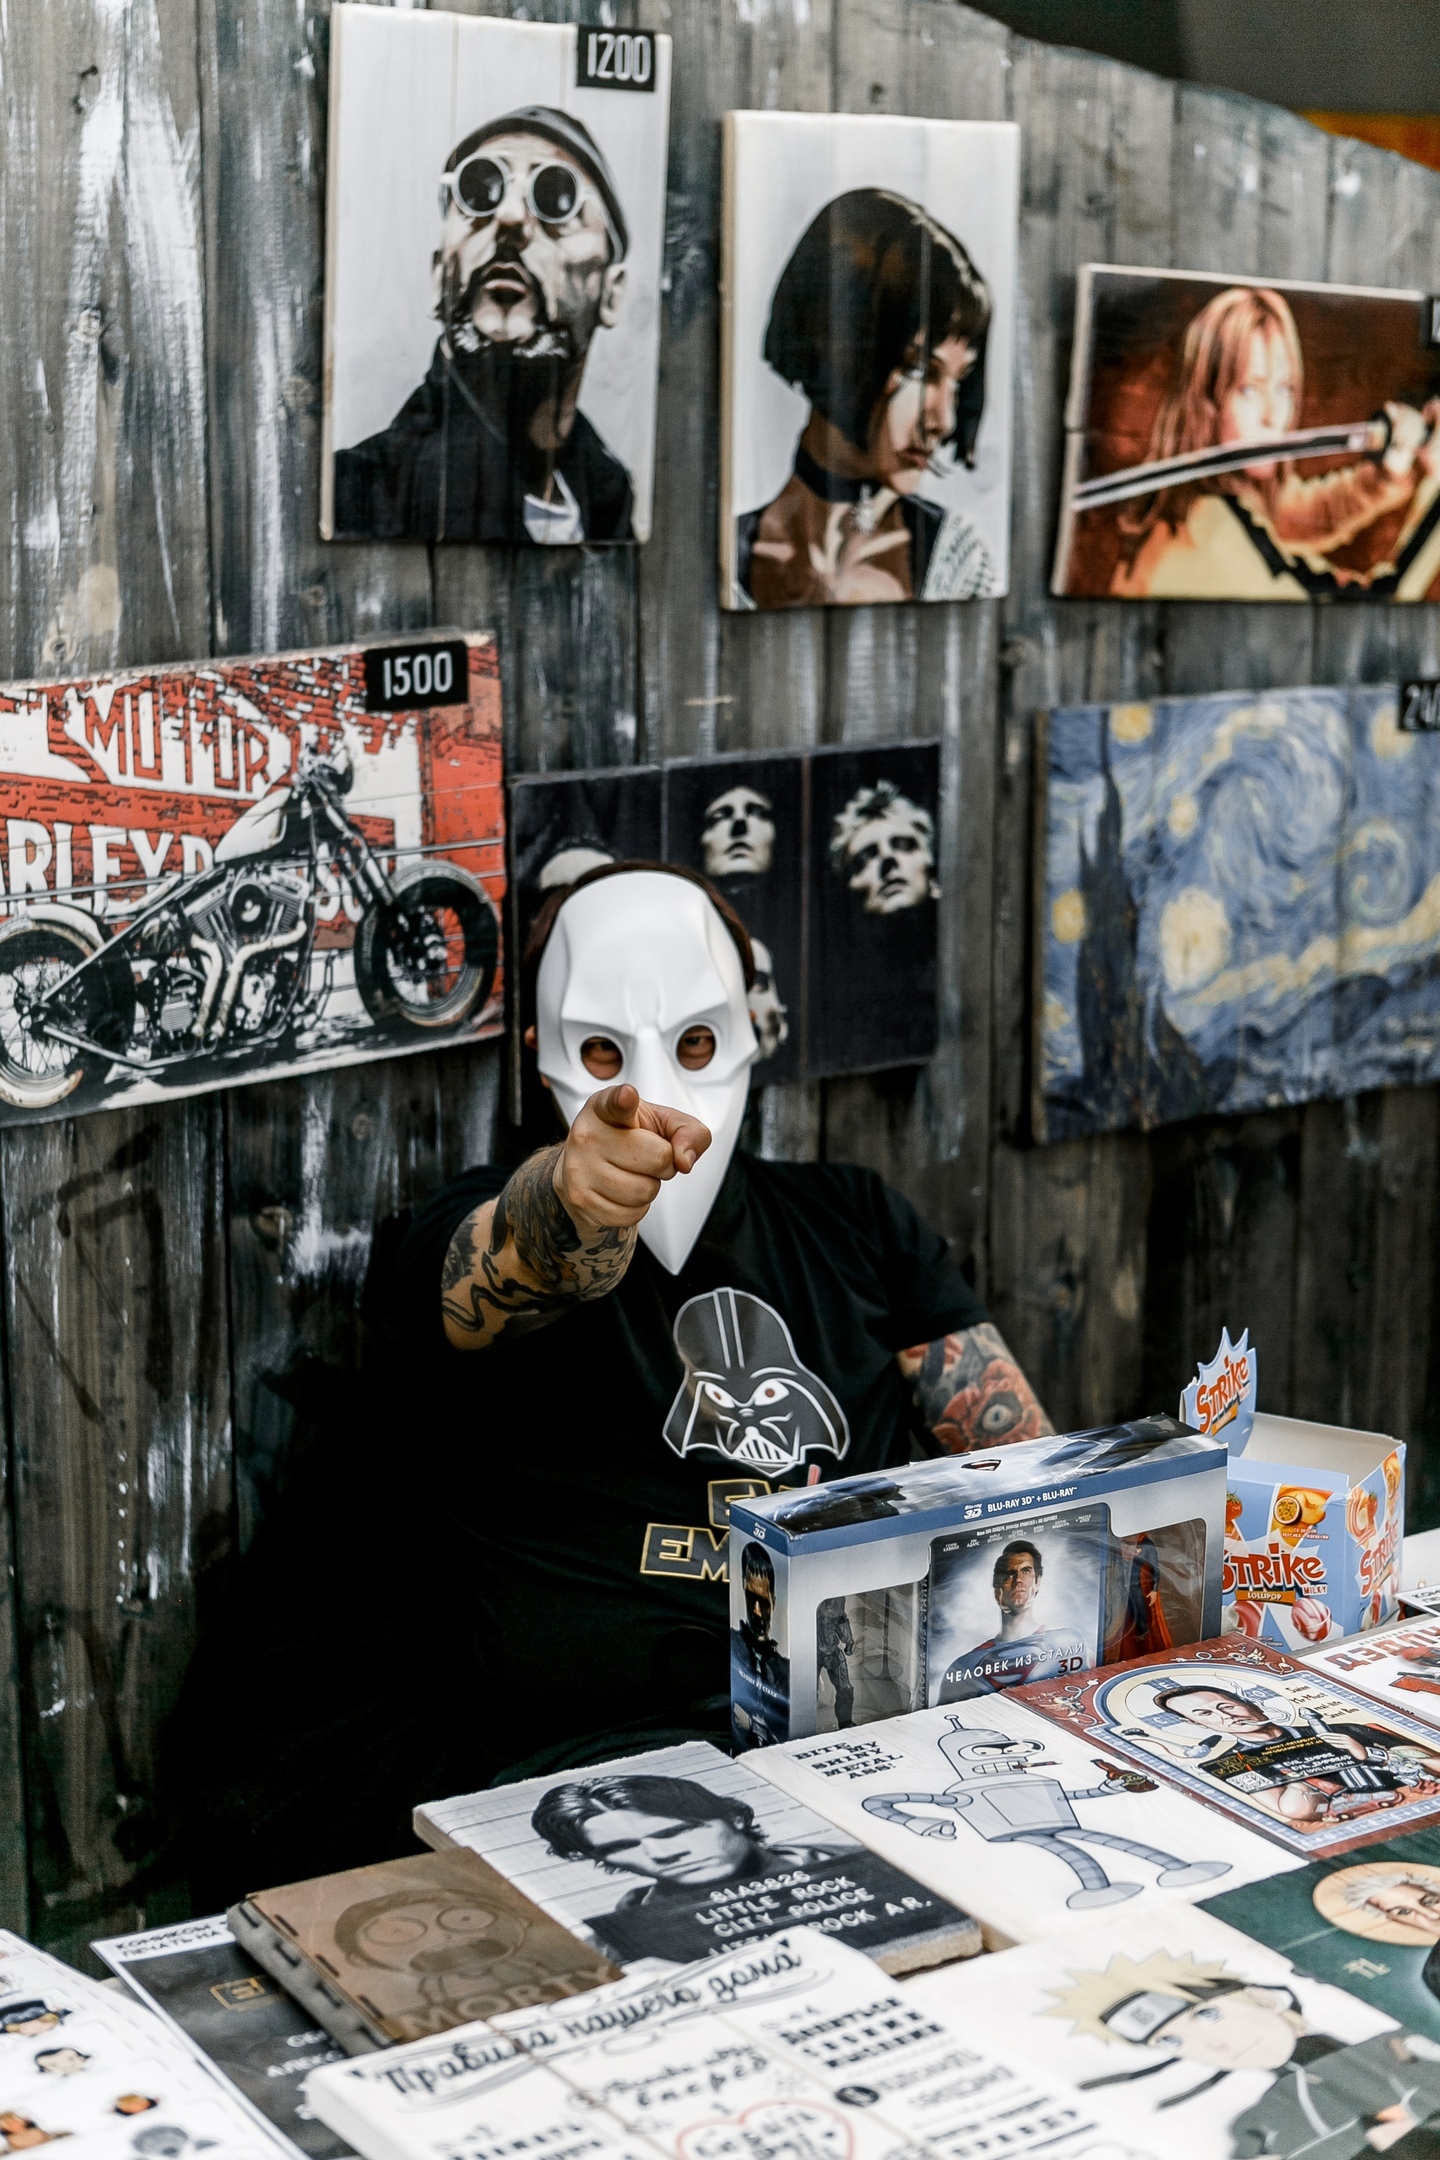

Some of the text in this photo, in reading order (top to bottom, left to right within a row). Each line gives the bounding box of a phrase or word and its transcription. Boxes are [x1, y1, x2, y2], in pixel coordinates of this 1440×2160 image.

[587, 32, 651, 83] 1200
[383, 651, 453, 699] 1500
[963, 1508, 982, 1520] 3D
[987, 1498, 1020, 1513] BLU-RAY
[1247, 1592, 1282, 1600] LOLLIPOP
[1303, 1585, 1327, 1595] MILKY
[946, 1642, 1084, 1683] ЧЕЛОВЕК ИЗ СТАЛИ
[1057, 1656, 1084, 1674] 3D
[793, 1741, 879, 1760] BITE MY
[811, 1748, 883, 1770] SHINY
[822, 1754, 904, 1777] METAL
[849, 1762, 896, 1780] ASS!
[710, 1870, 811, 1904] 81A3826
[695, 1876, 857, 1925] LITTLE ROCK
[713, 1887, 875, 1938] CITY POLICE
[807, 1908, 877, 1933] ROCK
[402, 1966, 610, 2040] MORTY
[376, 2028, 557, 2096] Правила
[561, 1985, 701, 2038] нашего
[707, 1949, 802, 2001] дома
